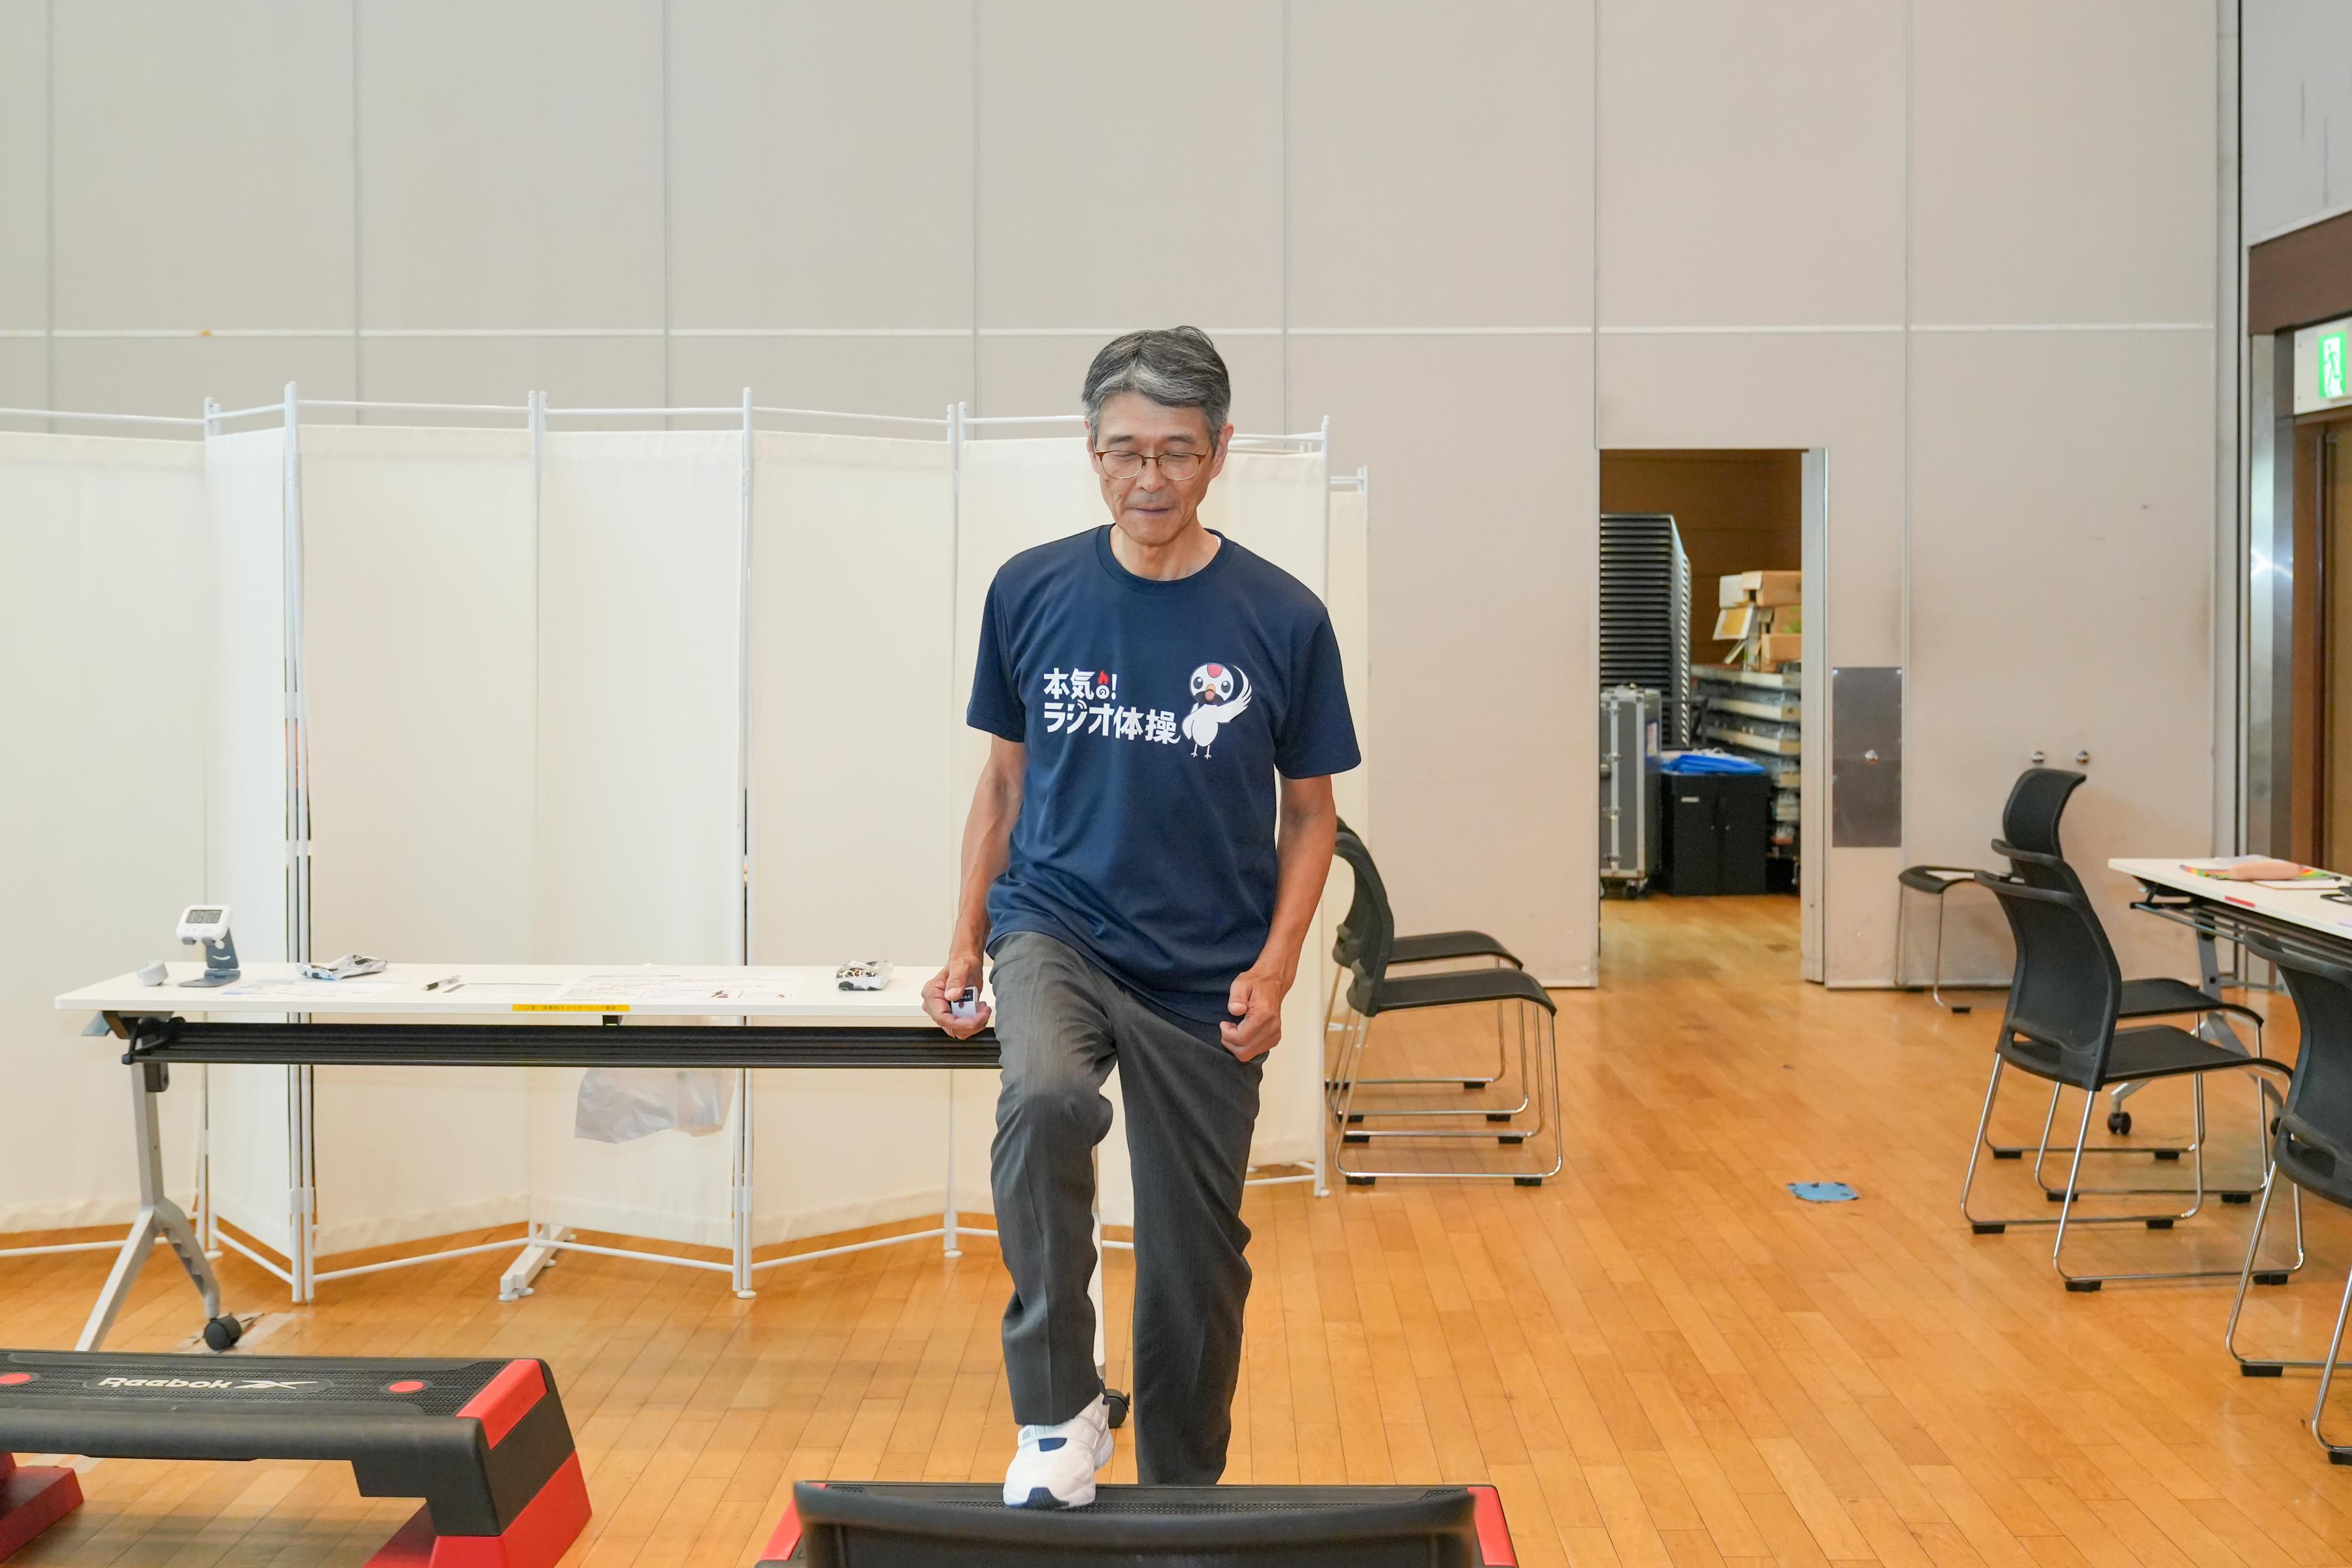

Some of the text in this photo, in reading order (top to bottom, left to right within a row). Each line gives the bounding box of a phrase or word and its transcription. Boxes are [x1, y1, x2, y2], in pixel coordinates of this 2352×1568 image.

[1043, 668, 1117, 700] 本気の!
[1043, 700, 1181, 745] ラジオ体操
[98, 1377, 233, 1389] Reebok
